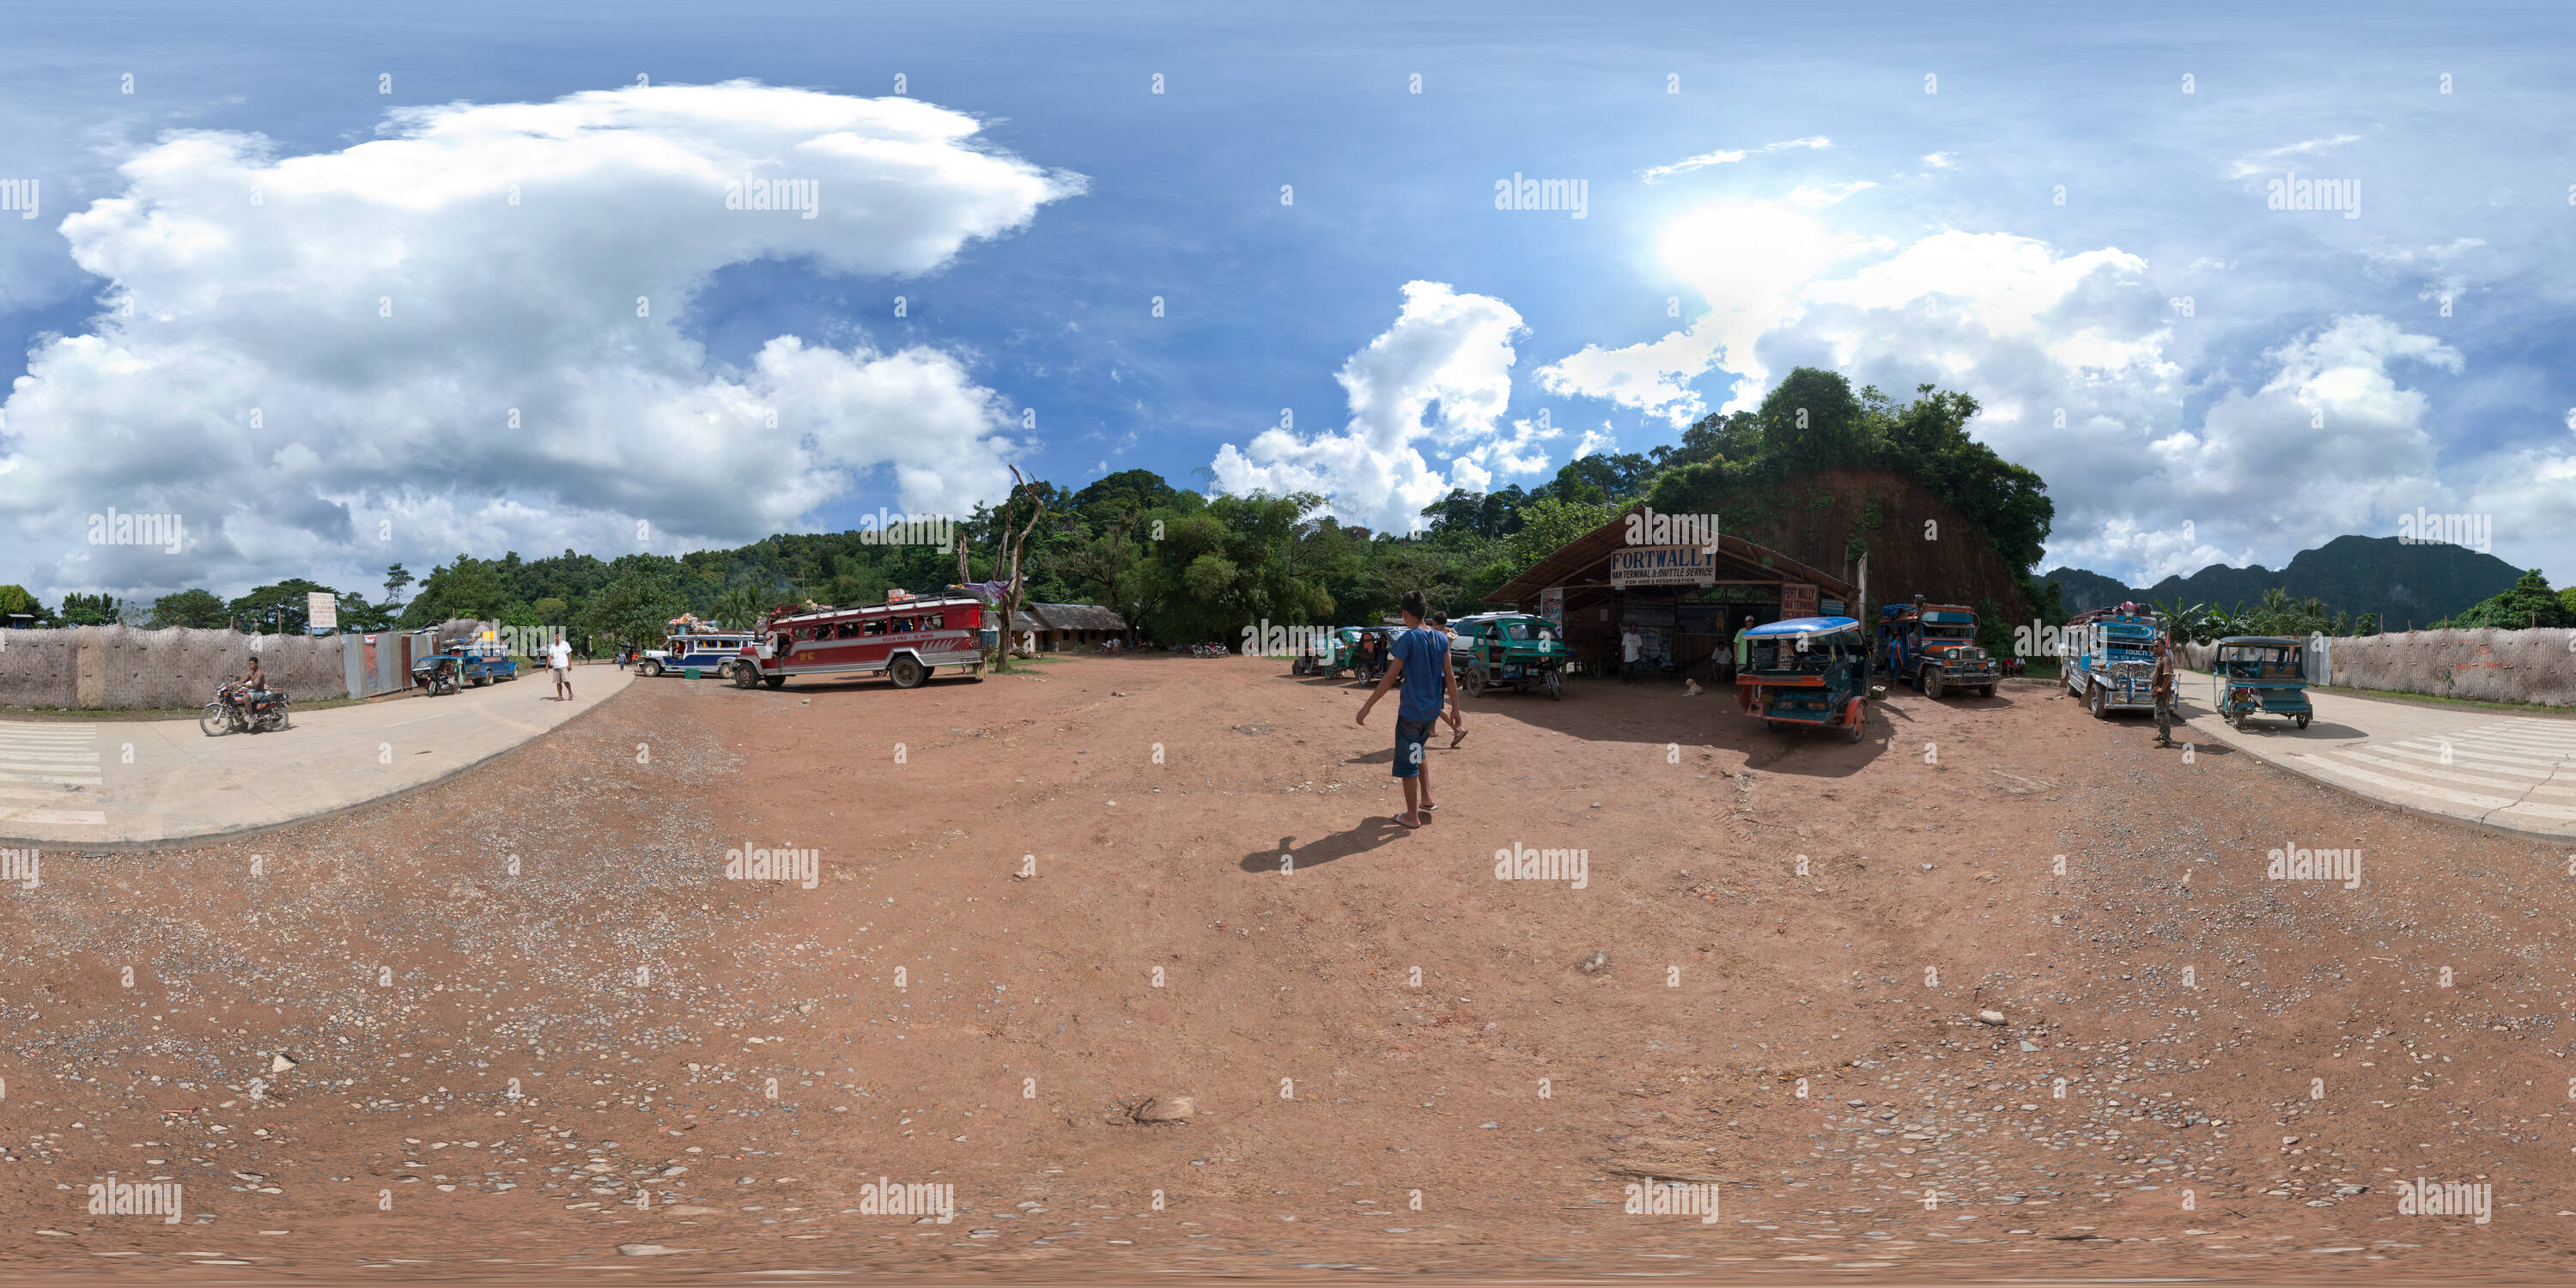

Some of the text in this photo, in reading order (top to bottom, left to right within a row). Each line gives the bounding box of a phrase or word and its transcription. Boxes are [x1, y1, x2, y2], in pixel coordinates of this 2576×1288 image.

[1612, 570, 1623, 580] VAN
[1623, 568, 1650, 579] TERMINAL
[1686, 568, 1713, 576] SERVICE
